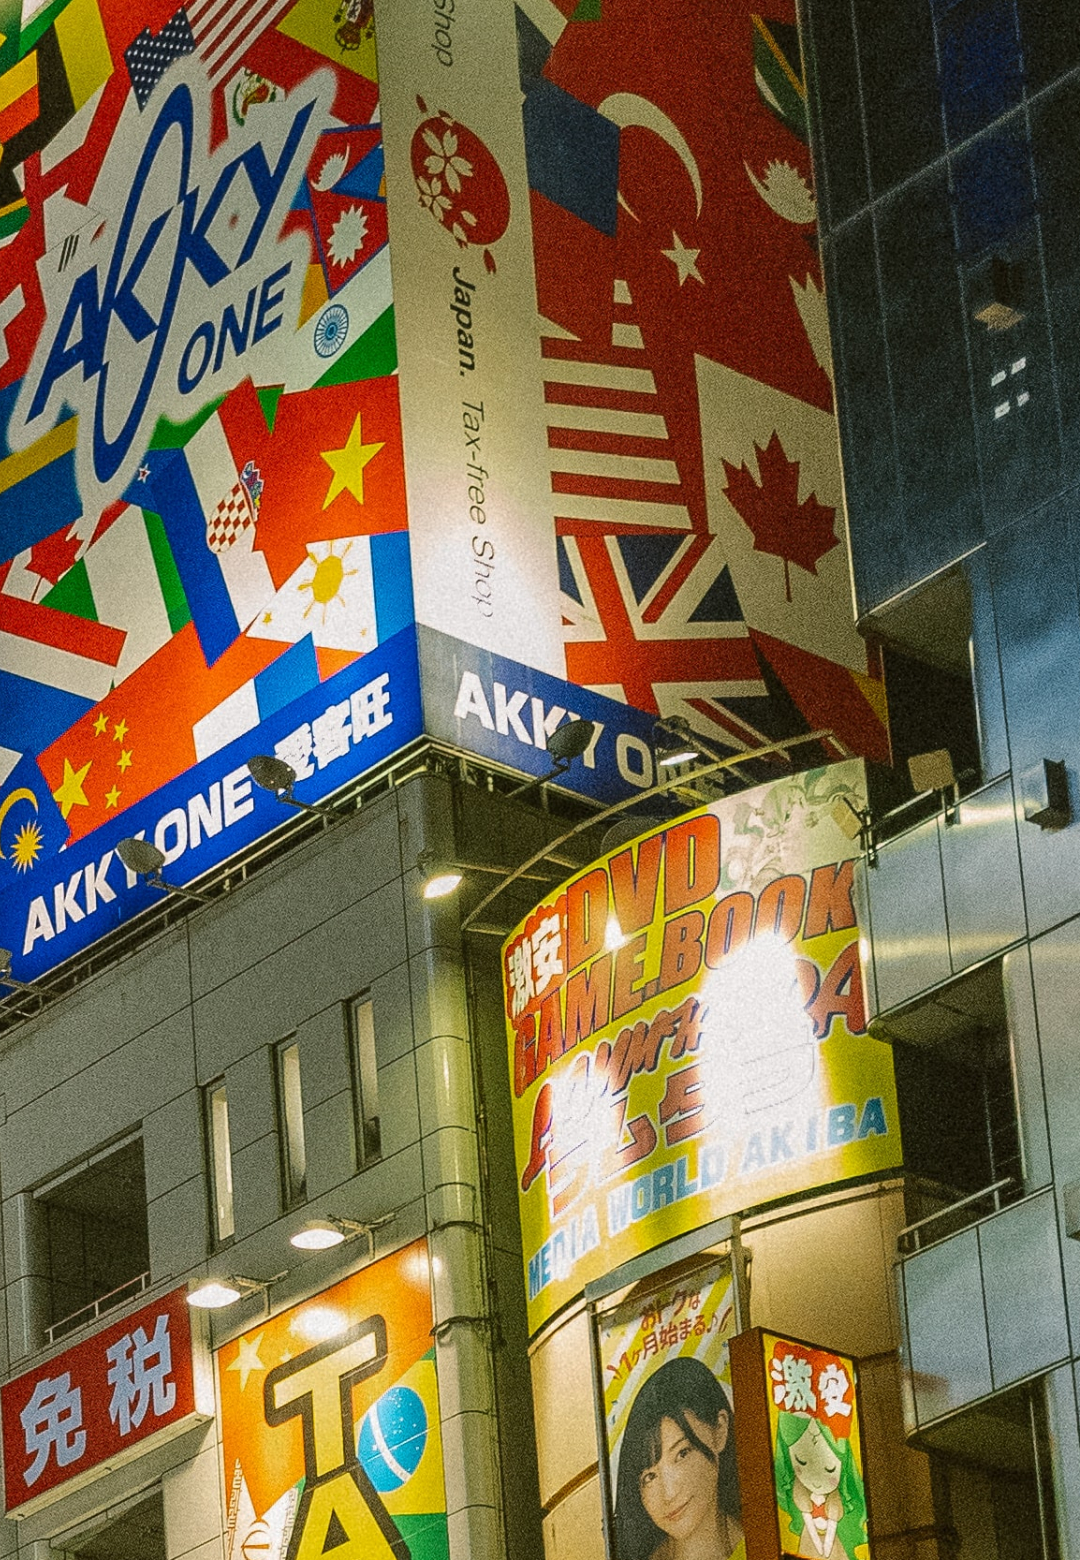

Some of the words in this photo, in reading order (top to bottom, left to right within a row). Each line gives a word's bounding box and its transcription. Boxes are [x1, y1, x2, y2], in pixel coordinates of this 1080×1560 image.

[29, 82, 319, 483] AKKY
[177, 262, 292, 397] ONE
[450, 266, 476, 377] Japan.
[461, 401, 488, 525] Tax-free
[472, 535, 495, 618] Shop
[154, 763, 256, 865] ONE
[564, 812, 721, 977] DVD
[528, 1203, 601, 1301] MEDIA
[607, 1146, 727, 1238] WORLD
[737, 1096, 889, 1177] AKIBA
[19, 1312, 177, 1488] 免税
[772, 1354, 852, 1420] 激安
